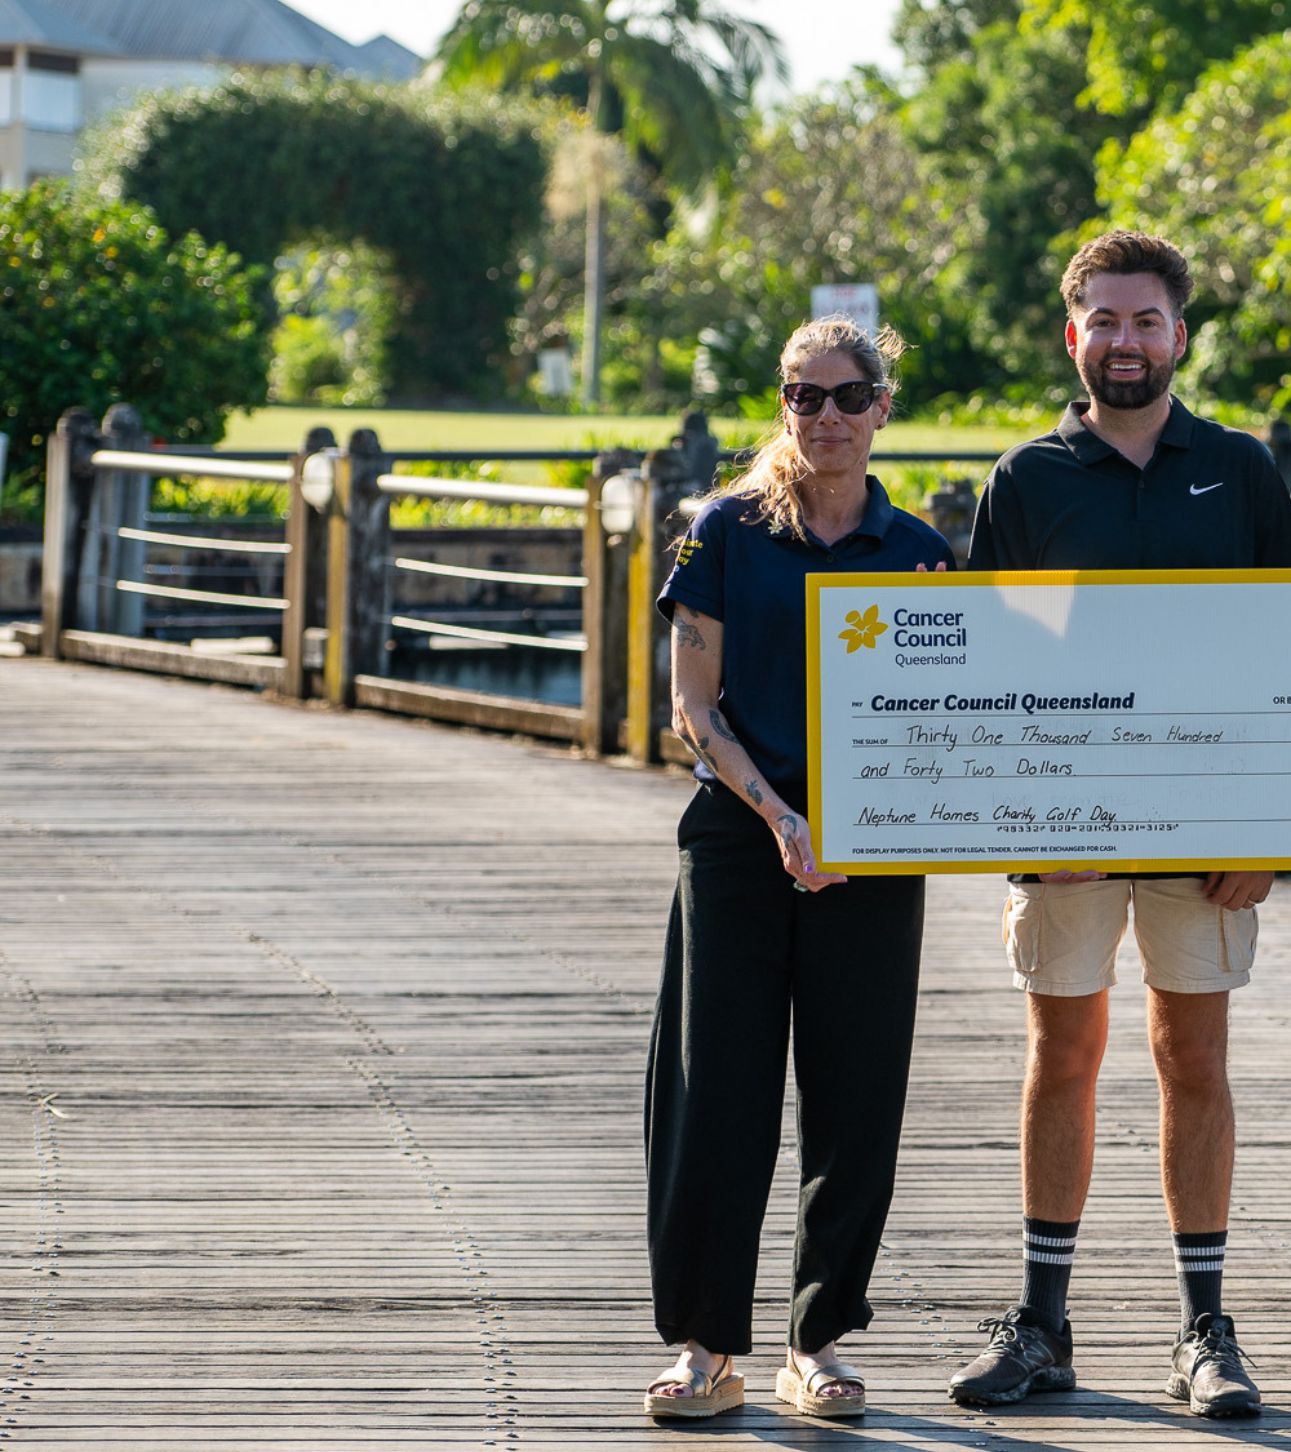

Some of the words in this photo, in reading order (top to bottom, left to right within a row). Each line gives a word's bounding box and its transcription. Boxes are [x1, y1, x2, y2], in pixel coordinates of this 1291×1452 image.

[894, 608, 964, 627] Cancer
[894, 629, 967, 647] Council
[895, 653, 967, 668] Queensland
[871, 695, 940, 711] Cancer
[944, 693, 1018, 711] Council
[1021, 692, 1135, 714] Queensland
[1273, 696, 1286, 704] OR
[906, 724, 958, 752] Thirty
[971, 725, 1004, 745] One
[1021, 725, 1092, 745] Thousand
[1112, 726, 1152, 742] Seven
[1166, 725, 1224, 743] Hundred
[860, 762, 890, 778] and
[903, 757, 943, 784] Forty
[963, 759, 995, 777] Two
[858, 806, 917, 827] Neptune
[930, 803, 980, 821] Homes
[993, 805, 1037, 824] Charity
[1046, 806, 1082, 821] Golf
